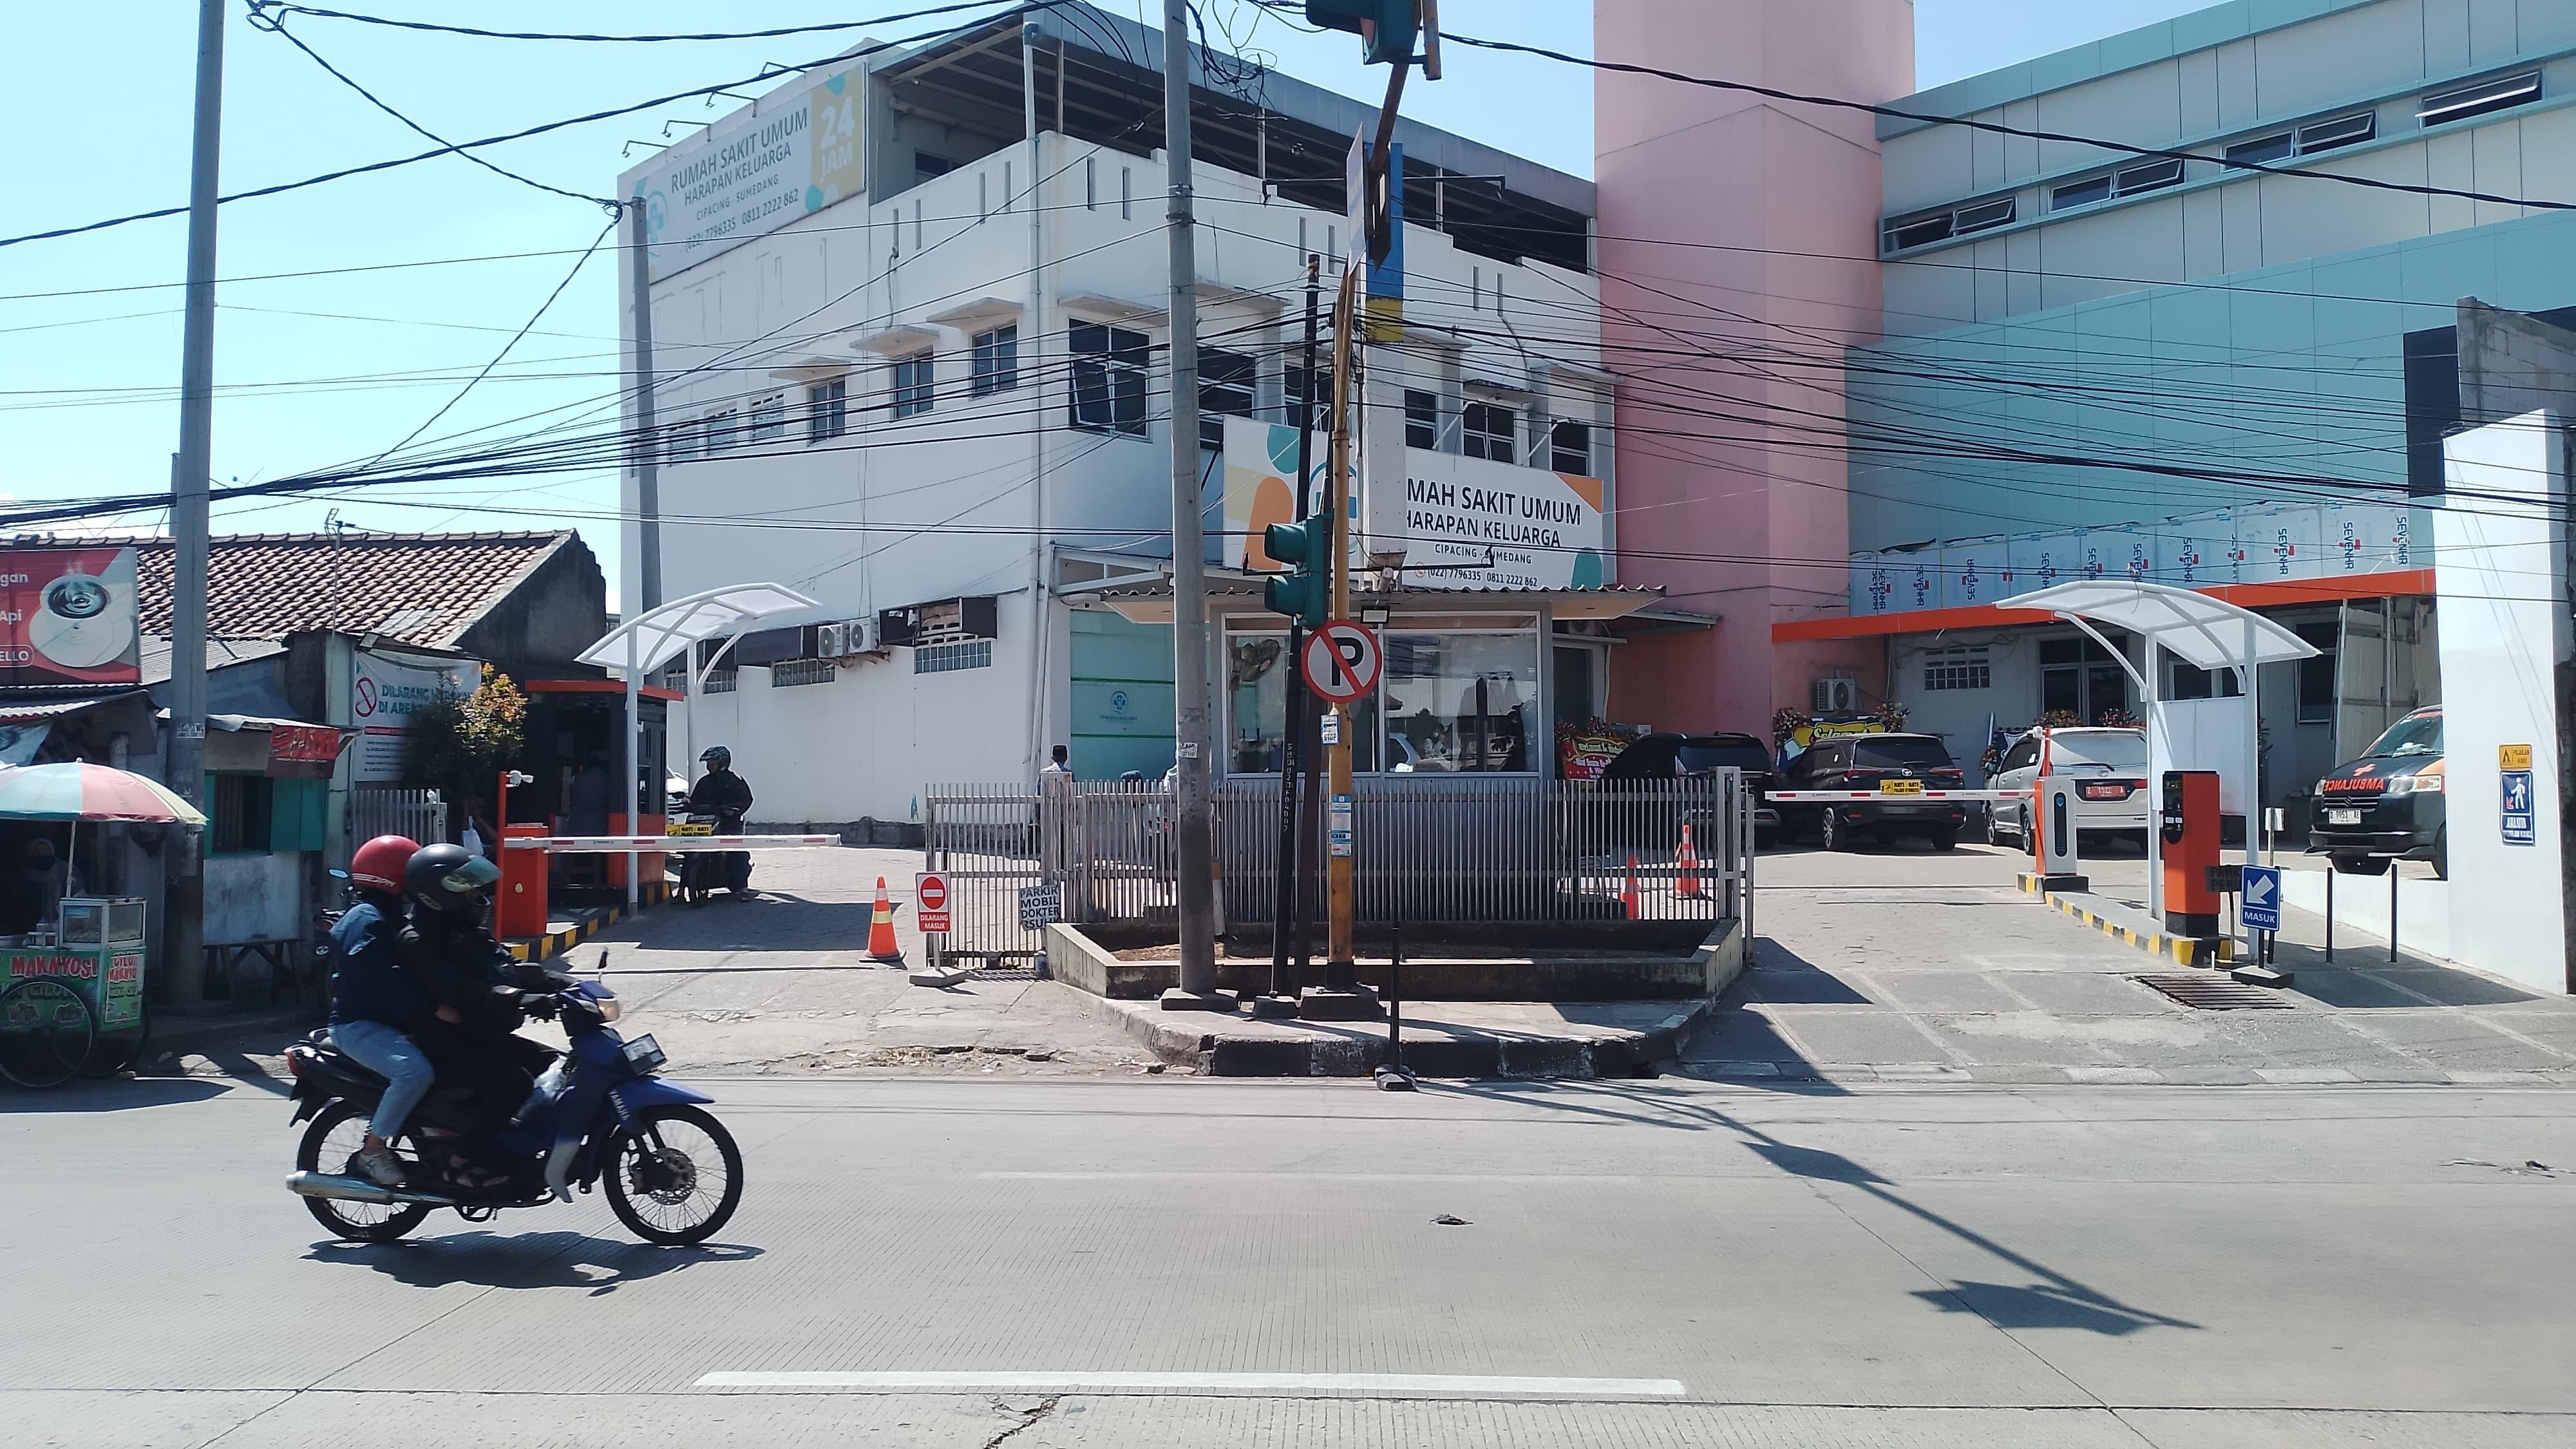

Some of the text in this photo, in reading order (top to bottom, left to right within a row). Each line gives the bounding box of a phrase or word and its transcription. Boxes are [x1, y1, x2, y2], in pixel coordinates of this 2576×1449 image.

[820, 96, 855, 149] 24
[672, 107, 807, 193] RUMAH SAKIT UMUM
[819, 142, 853, 183] JAM
[685, 142, 791, 206] HARAPAN KELUARGA
[697, 197, 730, 220] CIPACING
[736, 174, 779, 203] SUMEDANG
[705, 217, 736, 238] 7796335
[742, 207, 761, 225] 0811
[762, 197, 781, 216] 2222
[784, 189, 799, 206] 862
[1407, 478, 1581, 526] MAH SAKIT UMUM
[1435, 544, 1477, 558] CIPACING
[1484, 520, 1560, 547] KELUARGA
[2278, 528, 2289, 574] SEVENHR
[2344, 522, 2354, 569] SEVENHR
[1450, 569, 1481, 581] 7796335
[1487, 572, 1504, 583] 0811
[1506, 574, 1523, 585] 2222
[1525, 576, 1537, 587] 862
[2041, 552, 2050, 589] SEVENH
[378, 700, 387, 713] DI
[381, 685, 429, 699] DILARANG
[1019, 886, 1058, 898] PARKIR
[1021, 896, 1060, 908] MOBIL
[1021, 906, 1060, 918] DOKTER
[2244, 911, 2276, 923] MASUK
